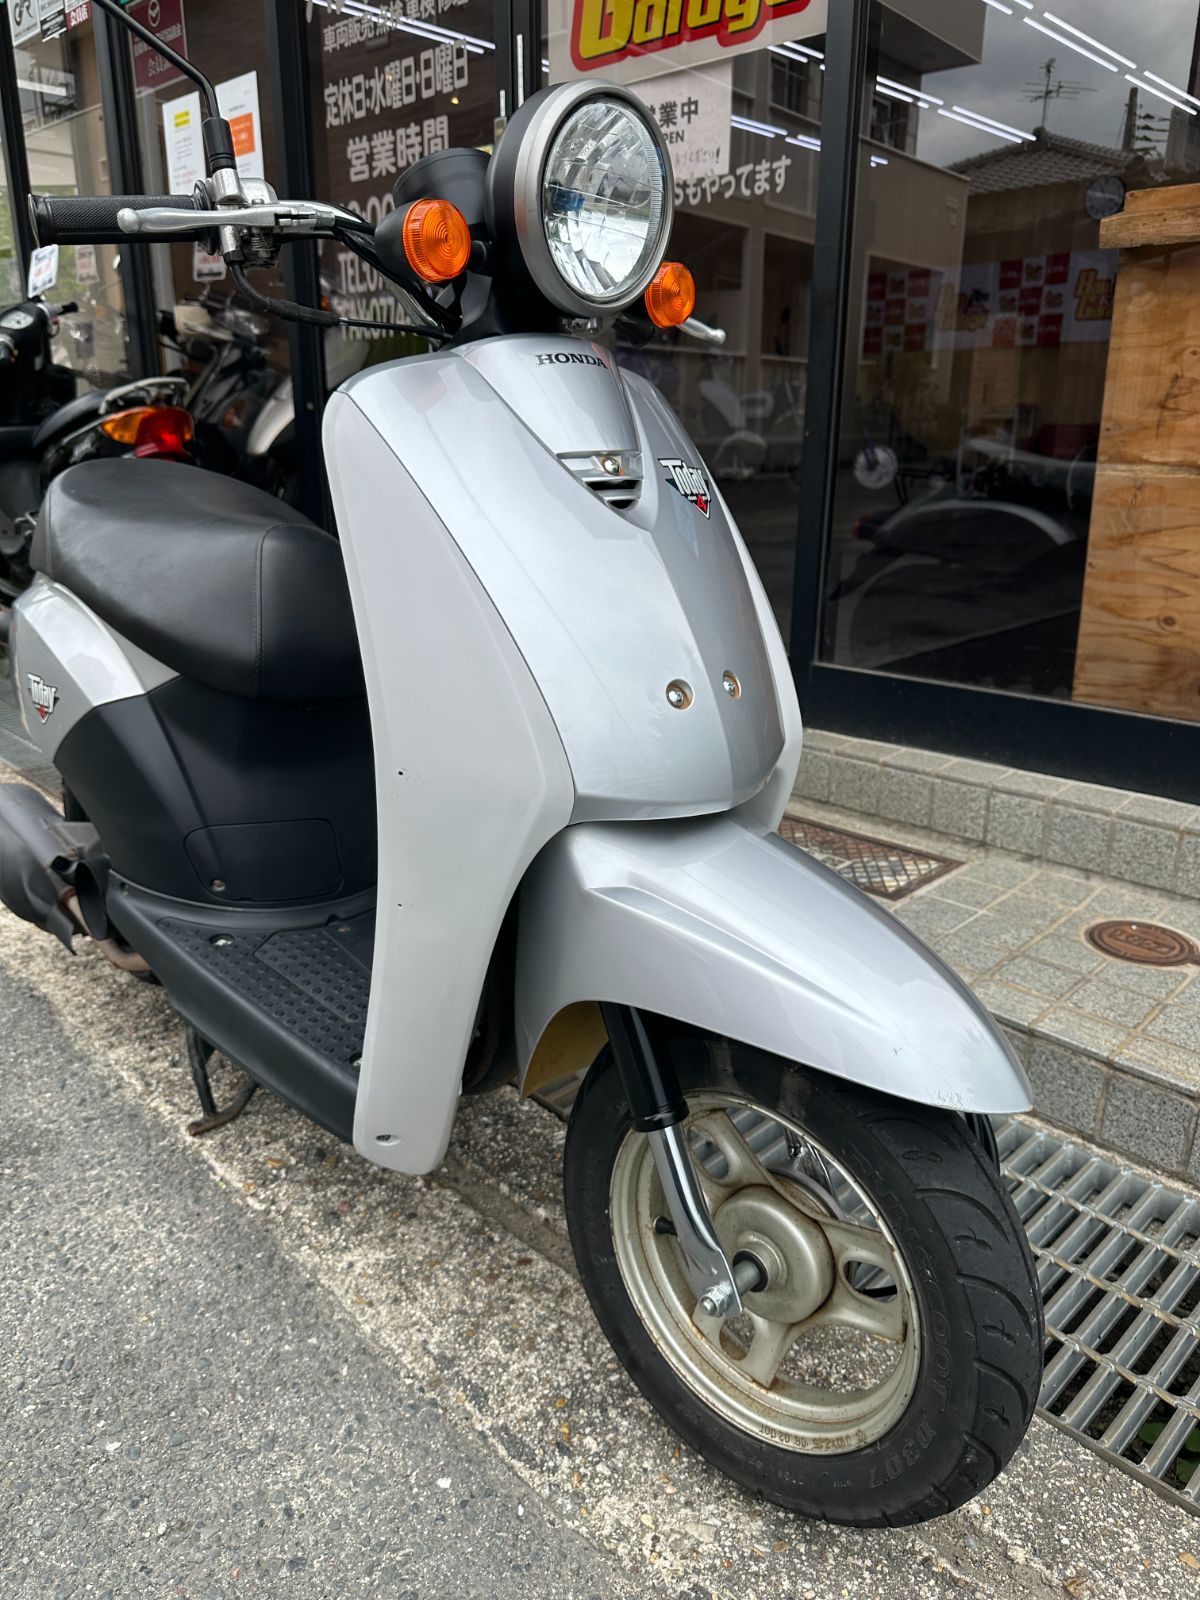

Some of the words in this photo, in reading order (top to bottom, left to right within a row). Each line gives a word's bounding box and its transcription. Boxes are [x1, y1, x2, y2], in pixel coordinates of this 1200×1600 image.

[347, 115, 450, 182] 営業時間
[661, 130, 685, 144] PEN
[535, 353, 608, 369] HONDA
[658, 459, 711, 503] Today
[27, 672, 58, 714] Today
